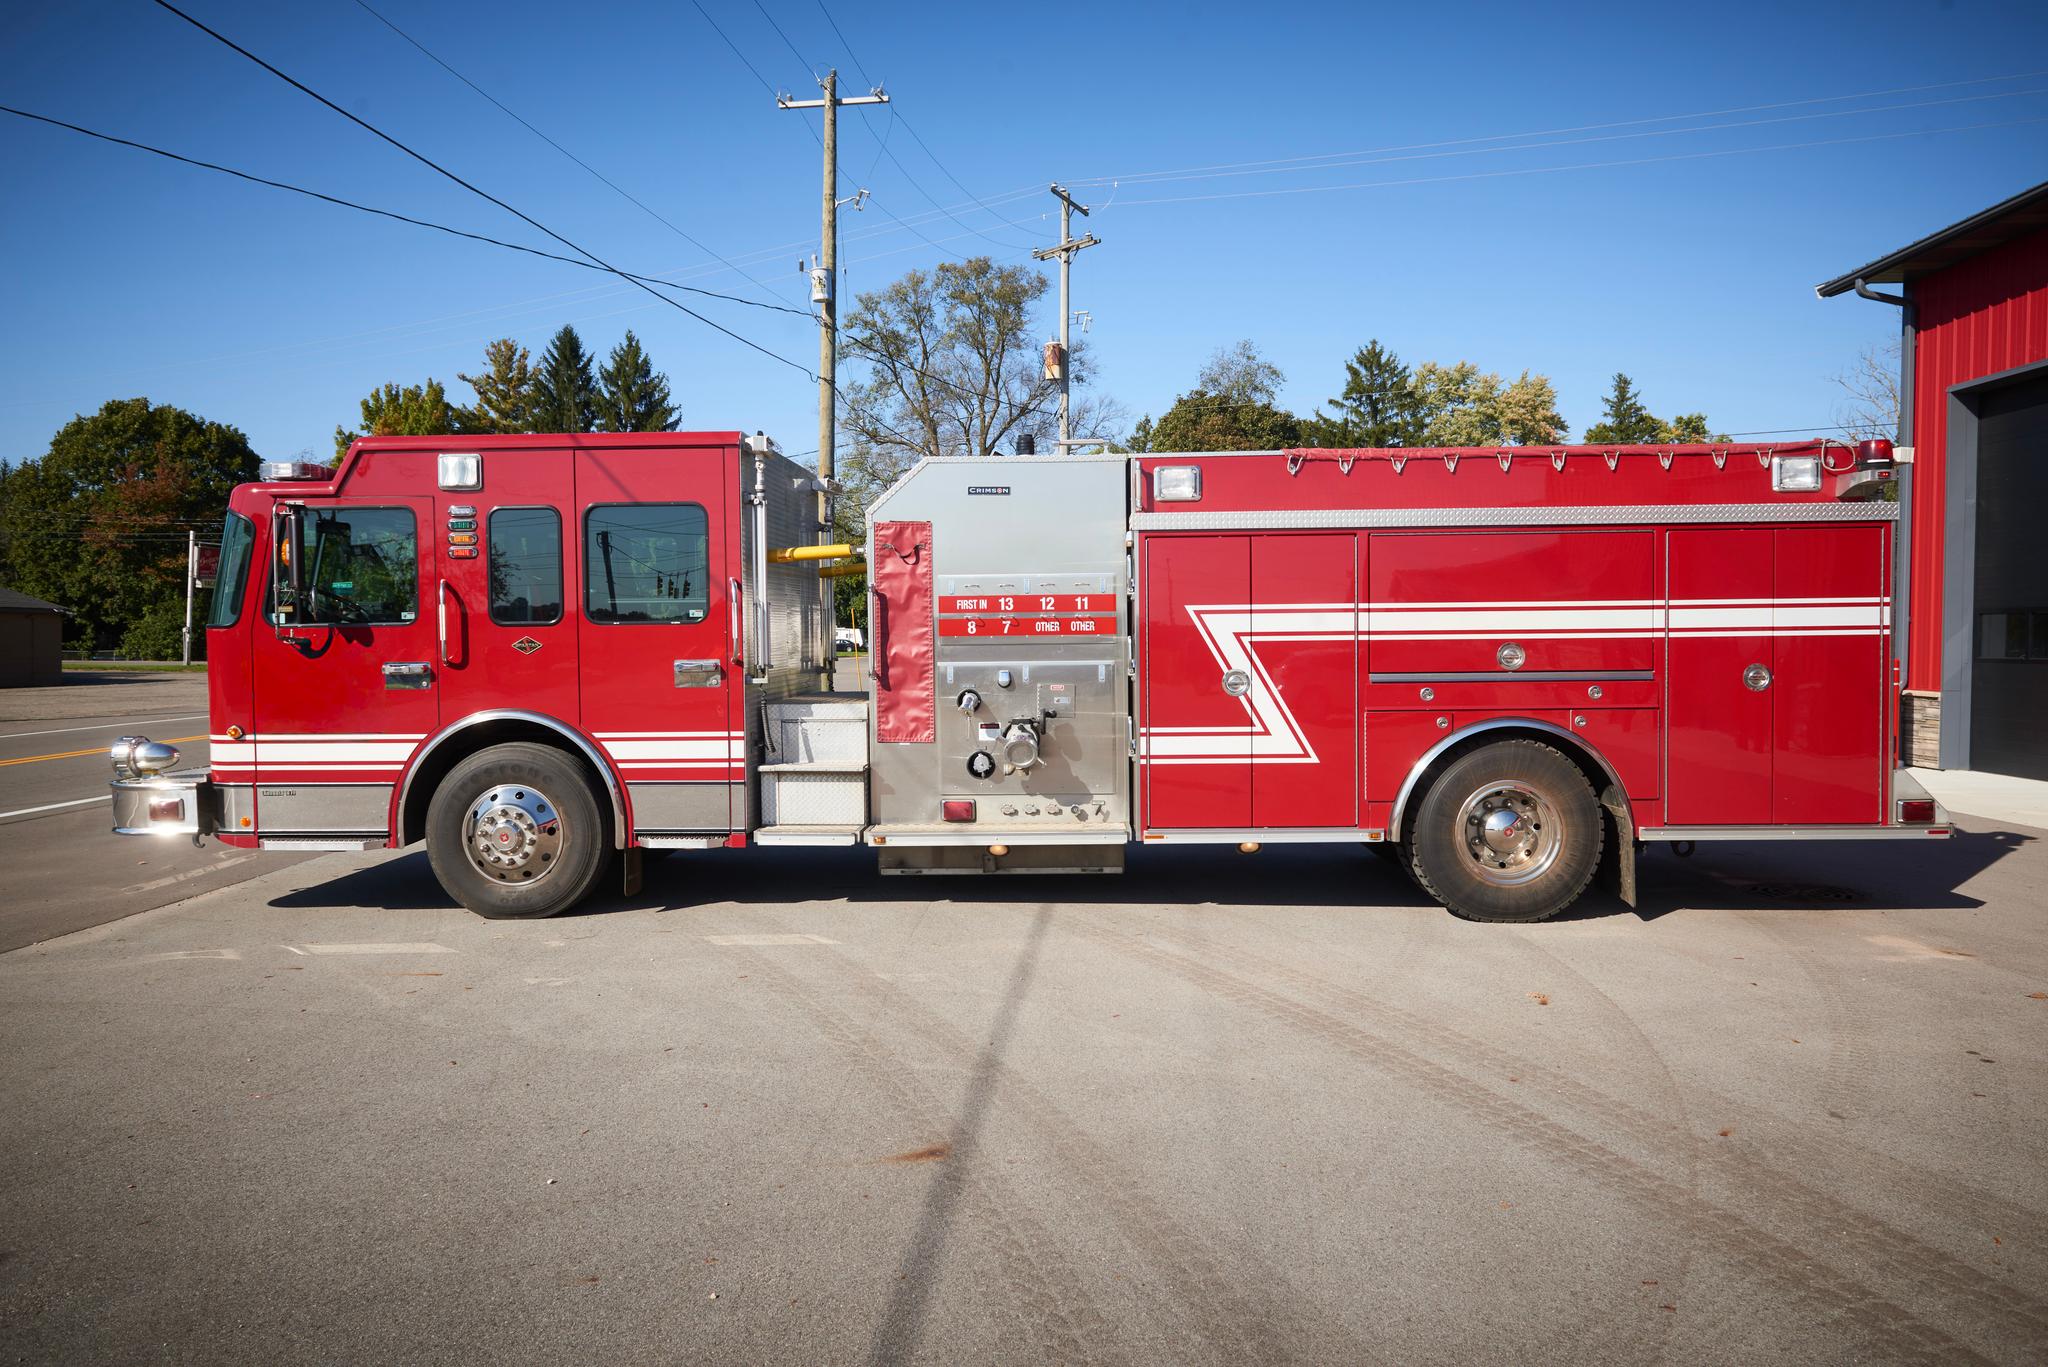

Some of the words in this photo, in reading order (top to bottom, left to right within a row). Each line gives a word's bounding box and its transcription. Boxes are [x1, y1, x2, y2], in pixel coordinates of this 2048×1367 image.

[956, 600, 978, 610] FIRST
[979, 600, 987, 610] IN
[998, 597, 1014, 611] 13
[1040, 597, 1055, 610] 12
[1075, 597, 1089, 610] 11
[967, 621, 977, 634] 8
[1002, 621, 1011, 634] 7
[1035, 621, 1060, 632] OTHER
[1071, 621, 1095, 632] OTHER
